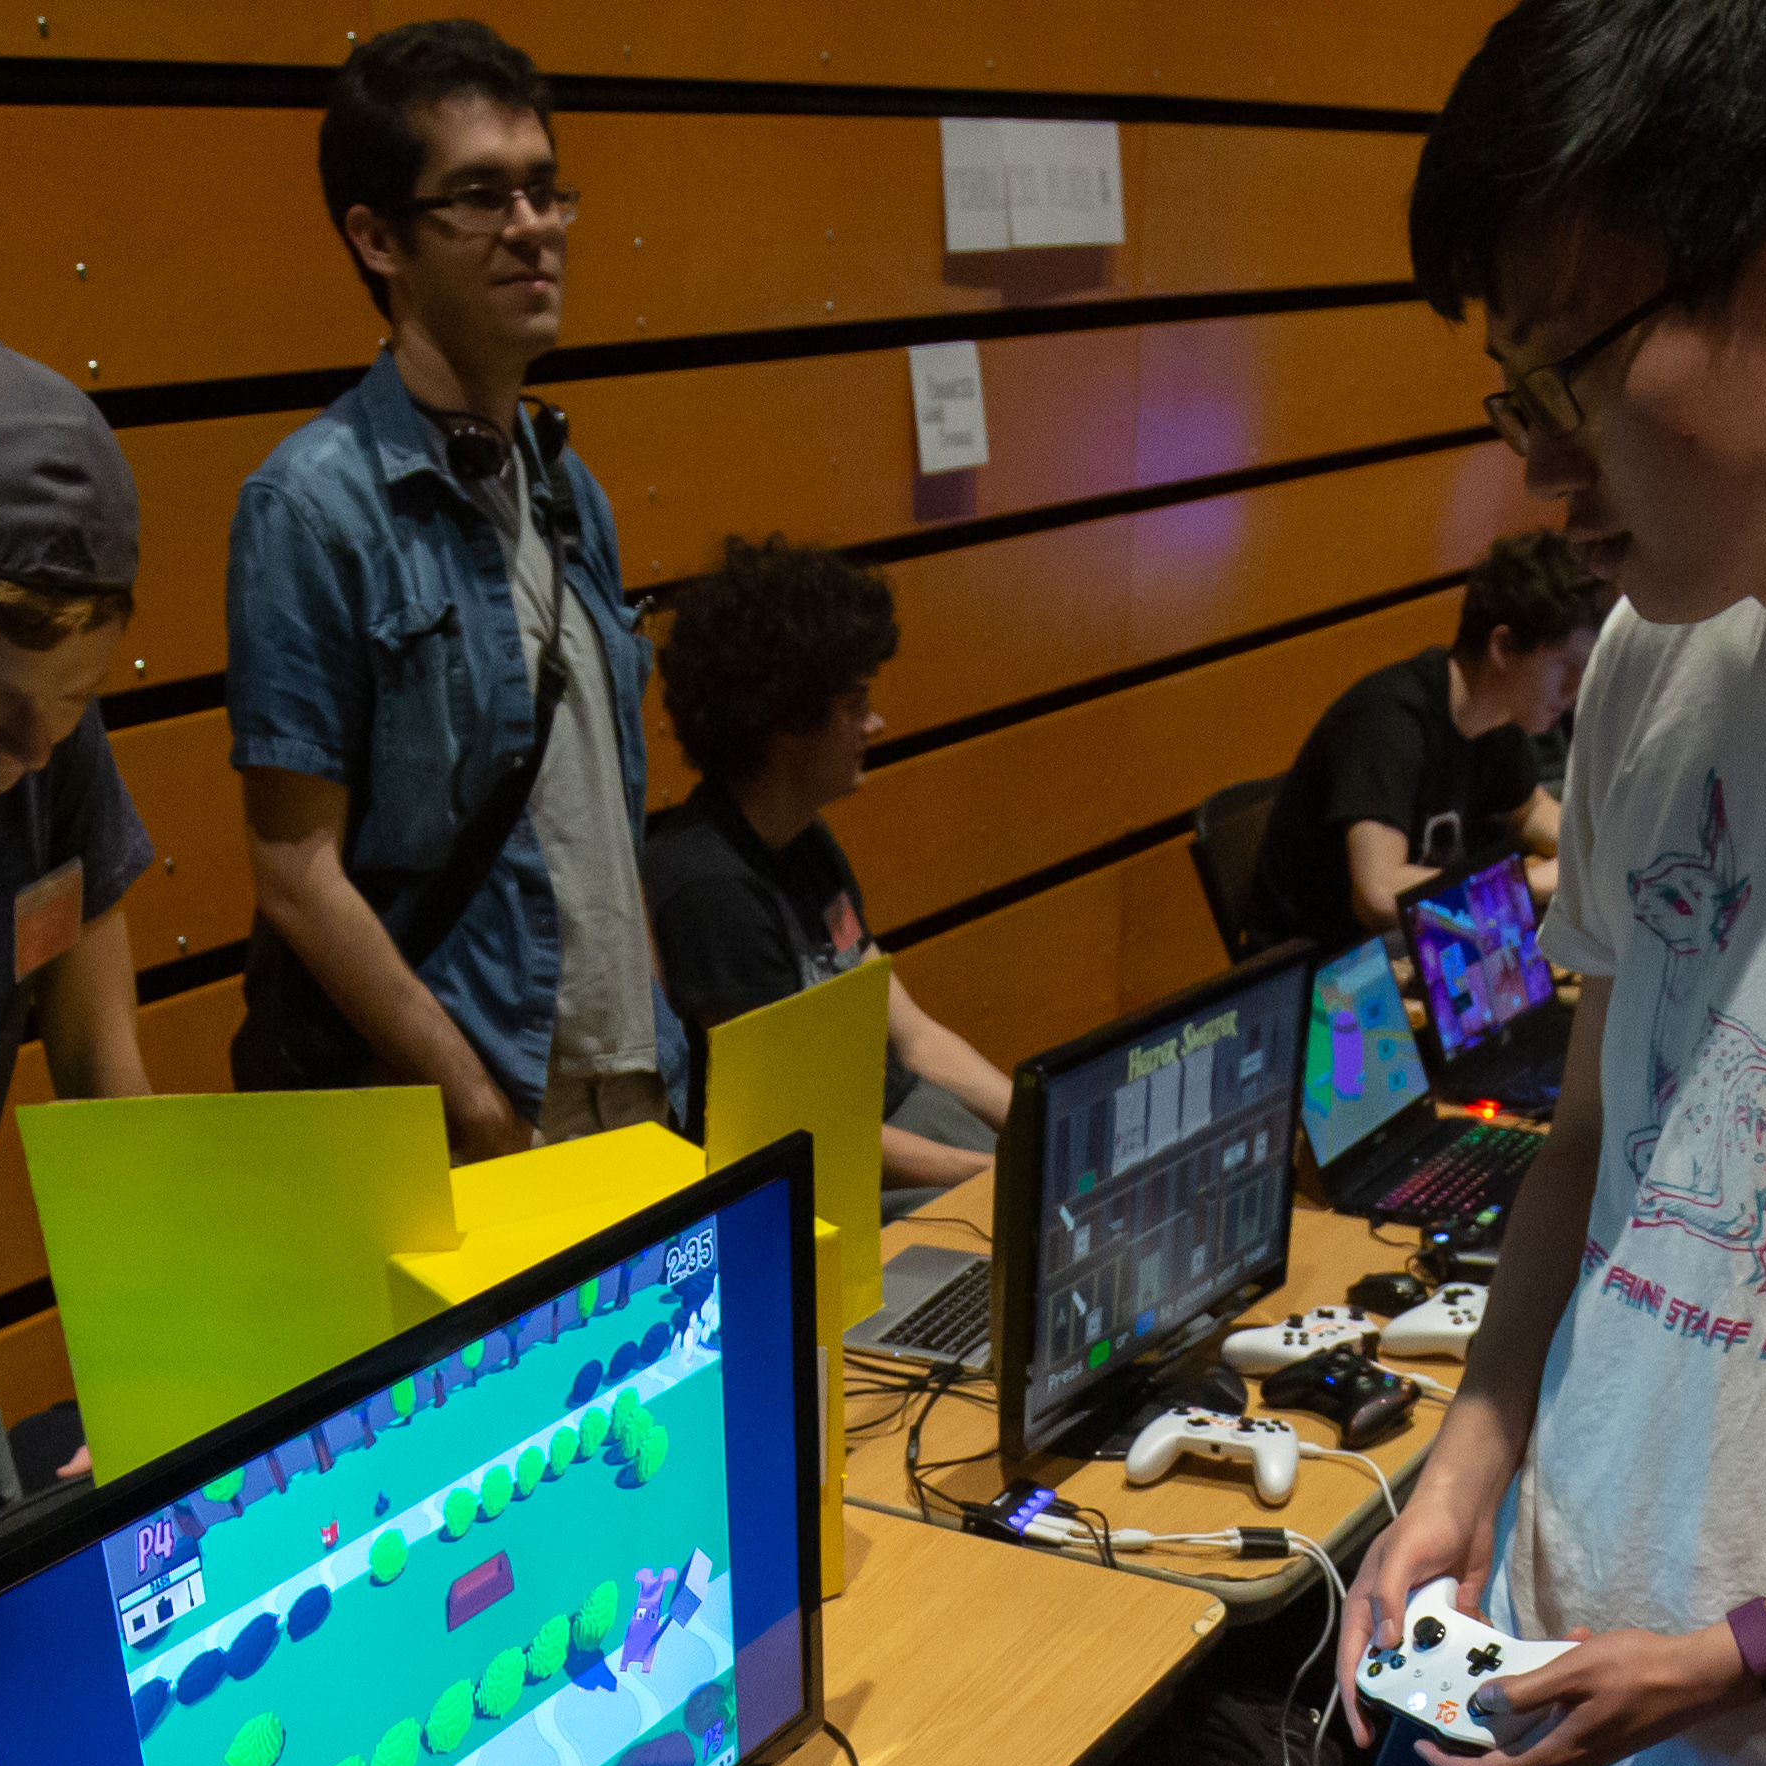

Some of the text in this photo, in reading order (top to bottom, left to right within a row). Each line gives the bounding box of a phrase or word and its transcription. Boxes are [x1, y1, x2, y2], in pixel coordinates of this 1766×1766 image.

[665, 1228, 714, 1287] 2:35
[1664, 1297, 1753, 1354] STAFF
[136, 1520, 174, 1574] P4
[702, 1718, 723, 1761] P3
